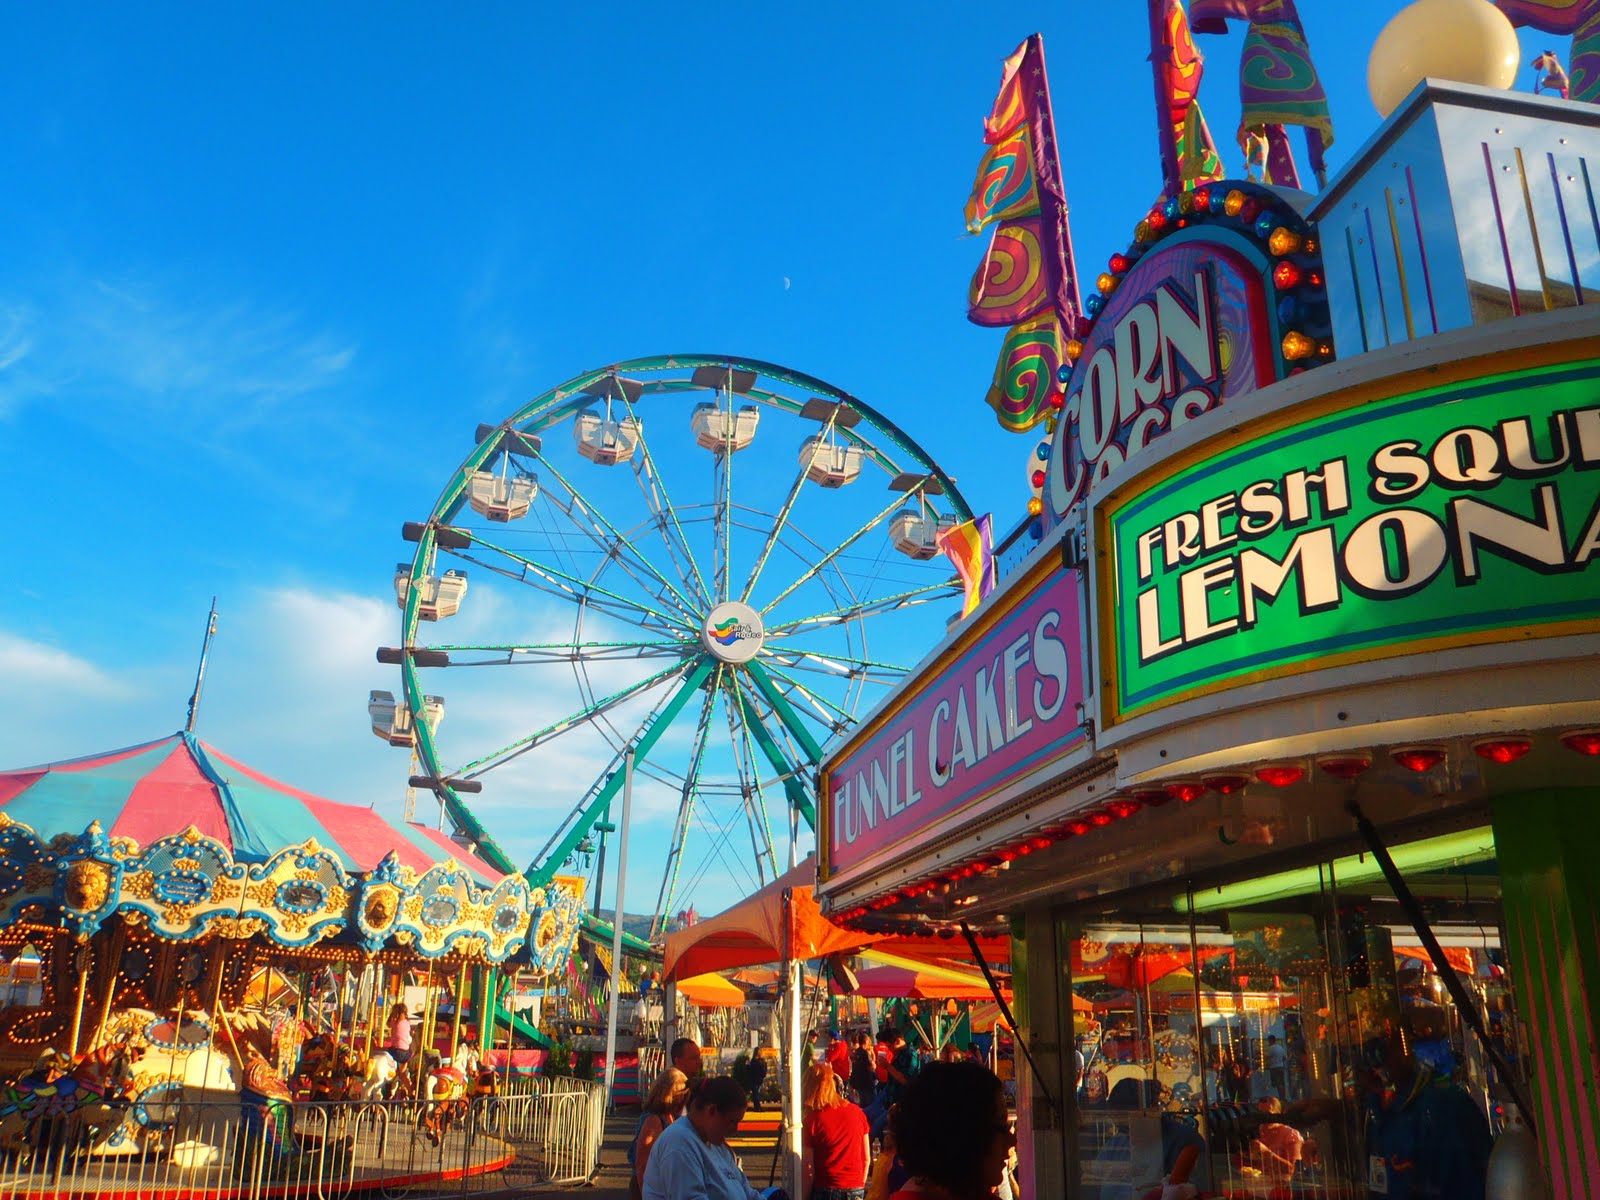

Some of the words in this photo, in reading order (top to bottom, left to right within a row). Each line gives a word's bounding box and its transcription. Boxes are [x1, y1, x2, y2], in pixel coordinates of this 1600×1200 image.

[1050, 270, 1216, 516] CORN
[1137, 457, 1350, 584] FRESH
[734, 631, 762, 639] Rodeo
[834, 729, 922, 853] FUNNEL
[928, 608, 1069, 788] CAKES
